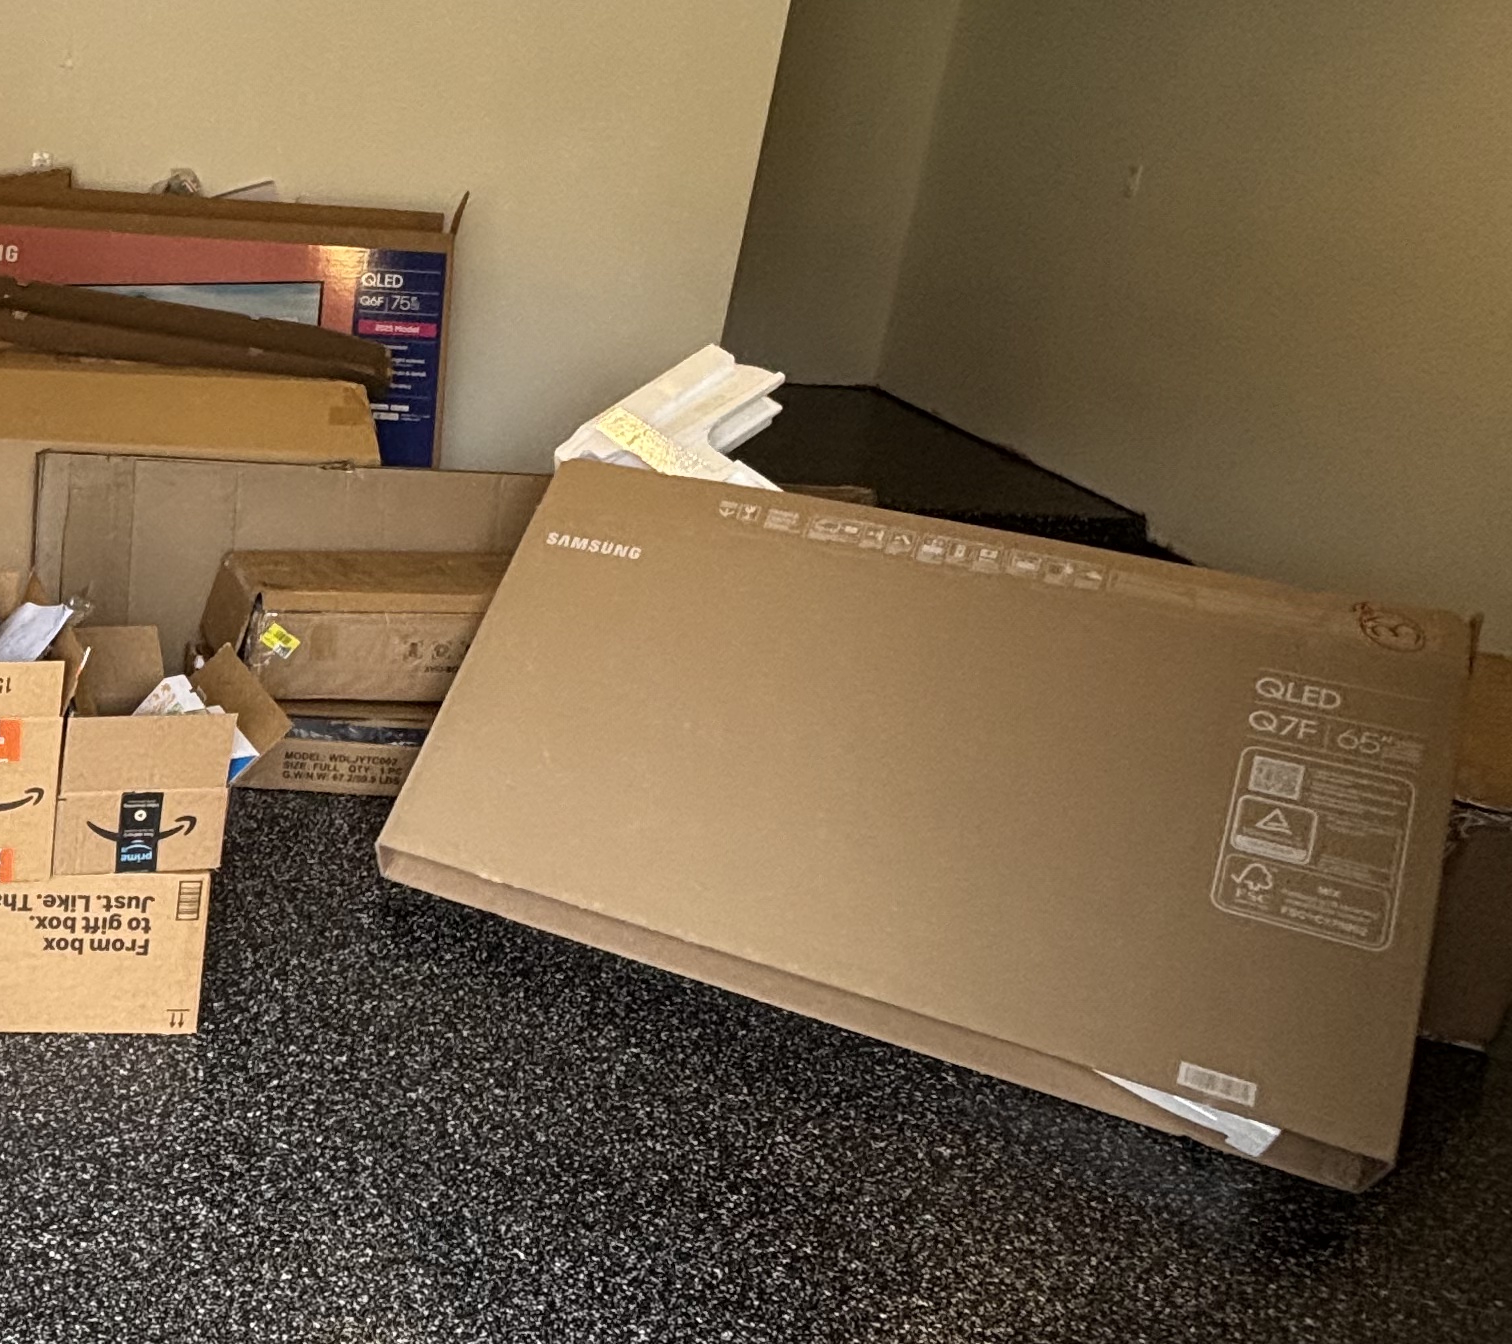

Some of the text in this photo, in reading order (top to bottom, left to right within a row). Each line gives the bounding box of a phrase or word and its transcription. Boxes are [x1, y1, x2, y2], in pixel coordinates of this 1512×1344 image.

[361, 272, 404, 288] QLED
[359, 295, 385, 307] Q6F
[546, 532, 642, 560] SAMSUNG
[1255, 677, 1341, 709] QLED
[1248, 710, 1319, 740] Q7F
[1337, 729, 1393, 754] 65"
[313, 762, 339, 771] FULL
[120, 850, 153, 863] prime
[36, 893, 91, 912] Like.
[96, 894, 155, 913] Just.
[29, 913, 152, 935] to gift box.
[42, 937, 150, 956] From box
